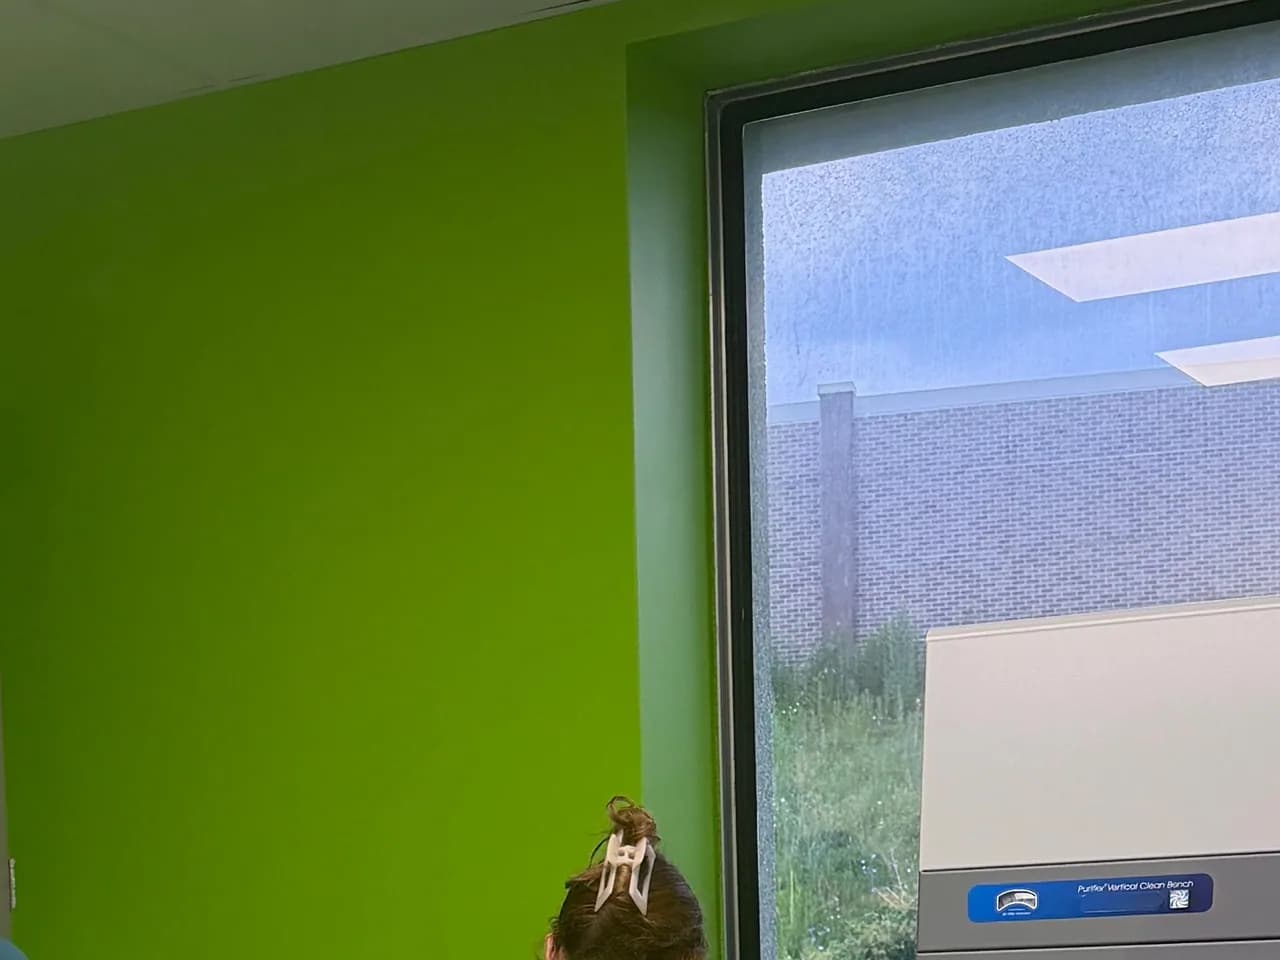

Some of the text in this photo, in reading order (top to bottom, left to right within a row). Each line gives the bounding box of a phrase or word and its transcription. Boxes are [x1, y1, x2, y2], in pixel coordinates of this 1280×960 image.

[1107, 882, 1138, 892] Vertical
[1139, 881, 1166, 890] Clean
[1167, 880, 1194, 889] Bench
